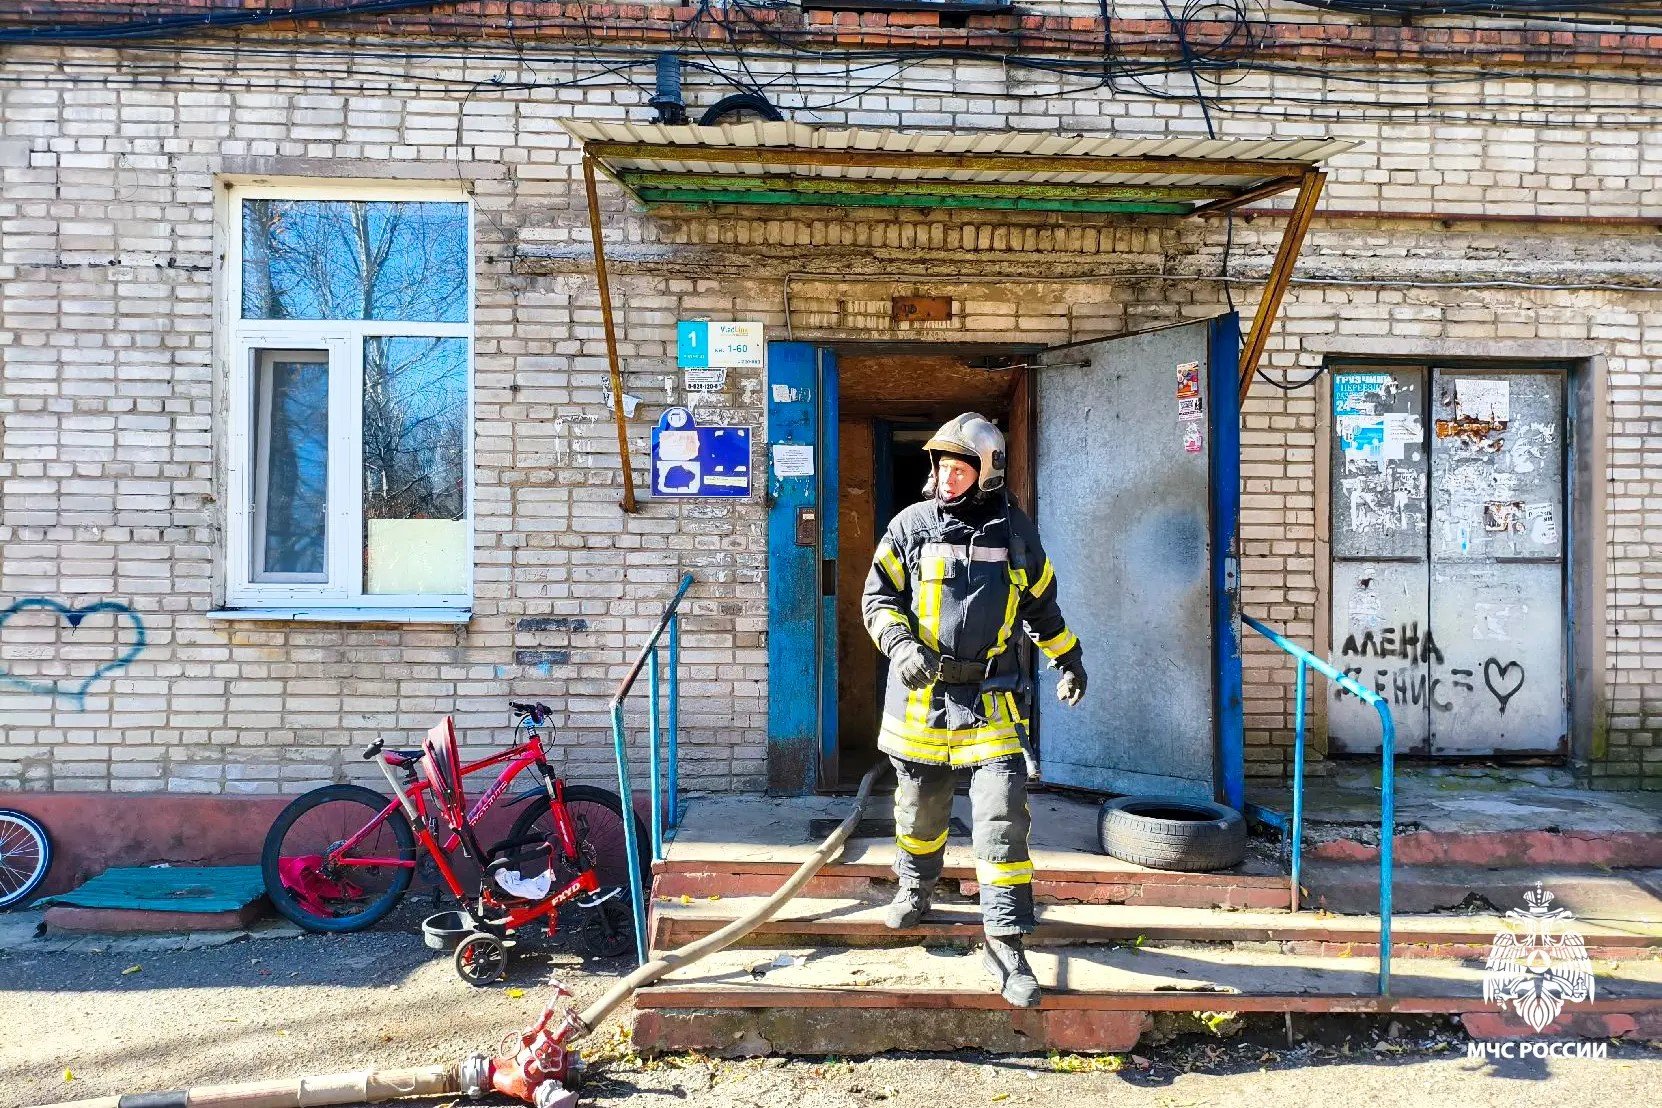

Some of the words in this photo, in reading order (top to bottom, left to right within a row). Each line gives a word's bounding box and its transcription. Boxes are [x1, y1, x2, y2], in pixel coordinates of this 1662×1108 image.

[688, 331, 697, 347] 1
[727, 344, 748, 353] 1-60
[1342, 621, 1444, 666] АЛЕНА
